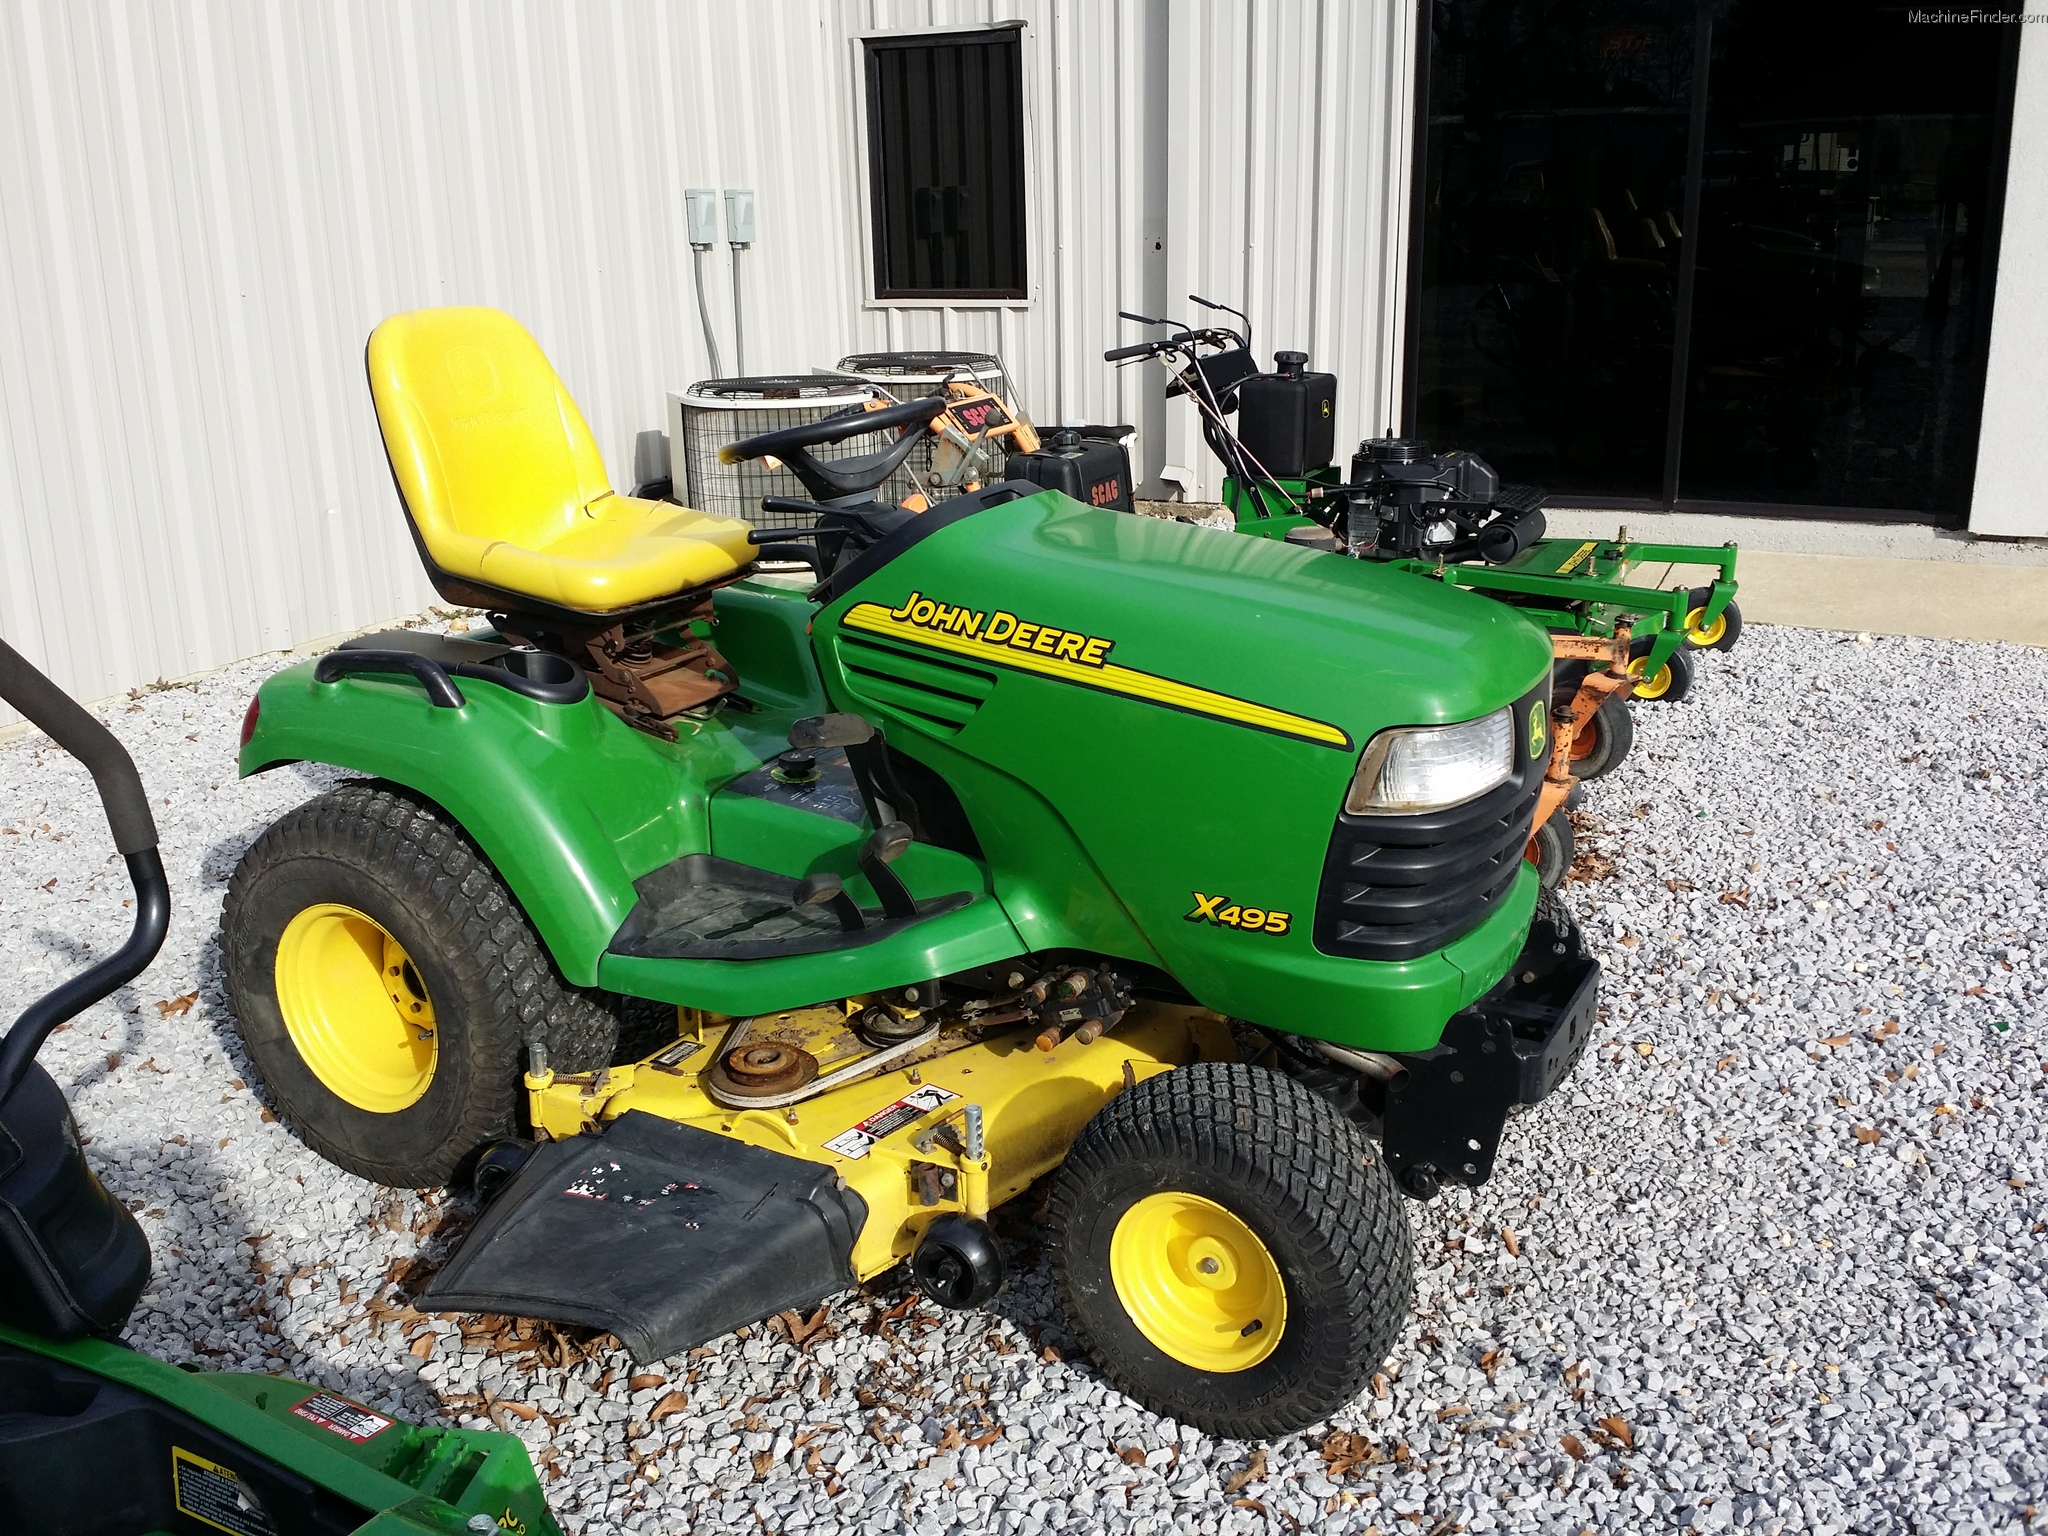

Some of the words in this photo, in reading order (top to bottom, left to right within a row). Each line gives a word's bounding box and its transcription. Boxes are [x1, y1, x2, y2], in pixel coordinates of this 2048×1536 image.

[1091, 479, 1118, 507] SCAG
[891, 590, 986, 640] JOHN
[982, 609, 1116, 669] DEERE
[1183, 891, 1294, 937] X495
[869, 1103, 899, 1124] DANGER
